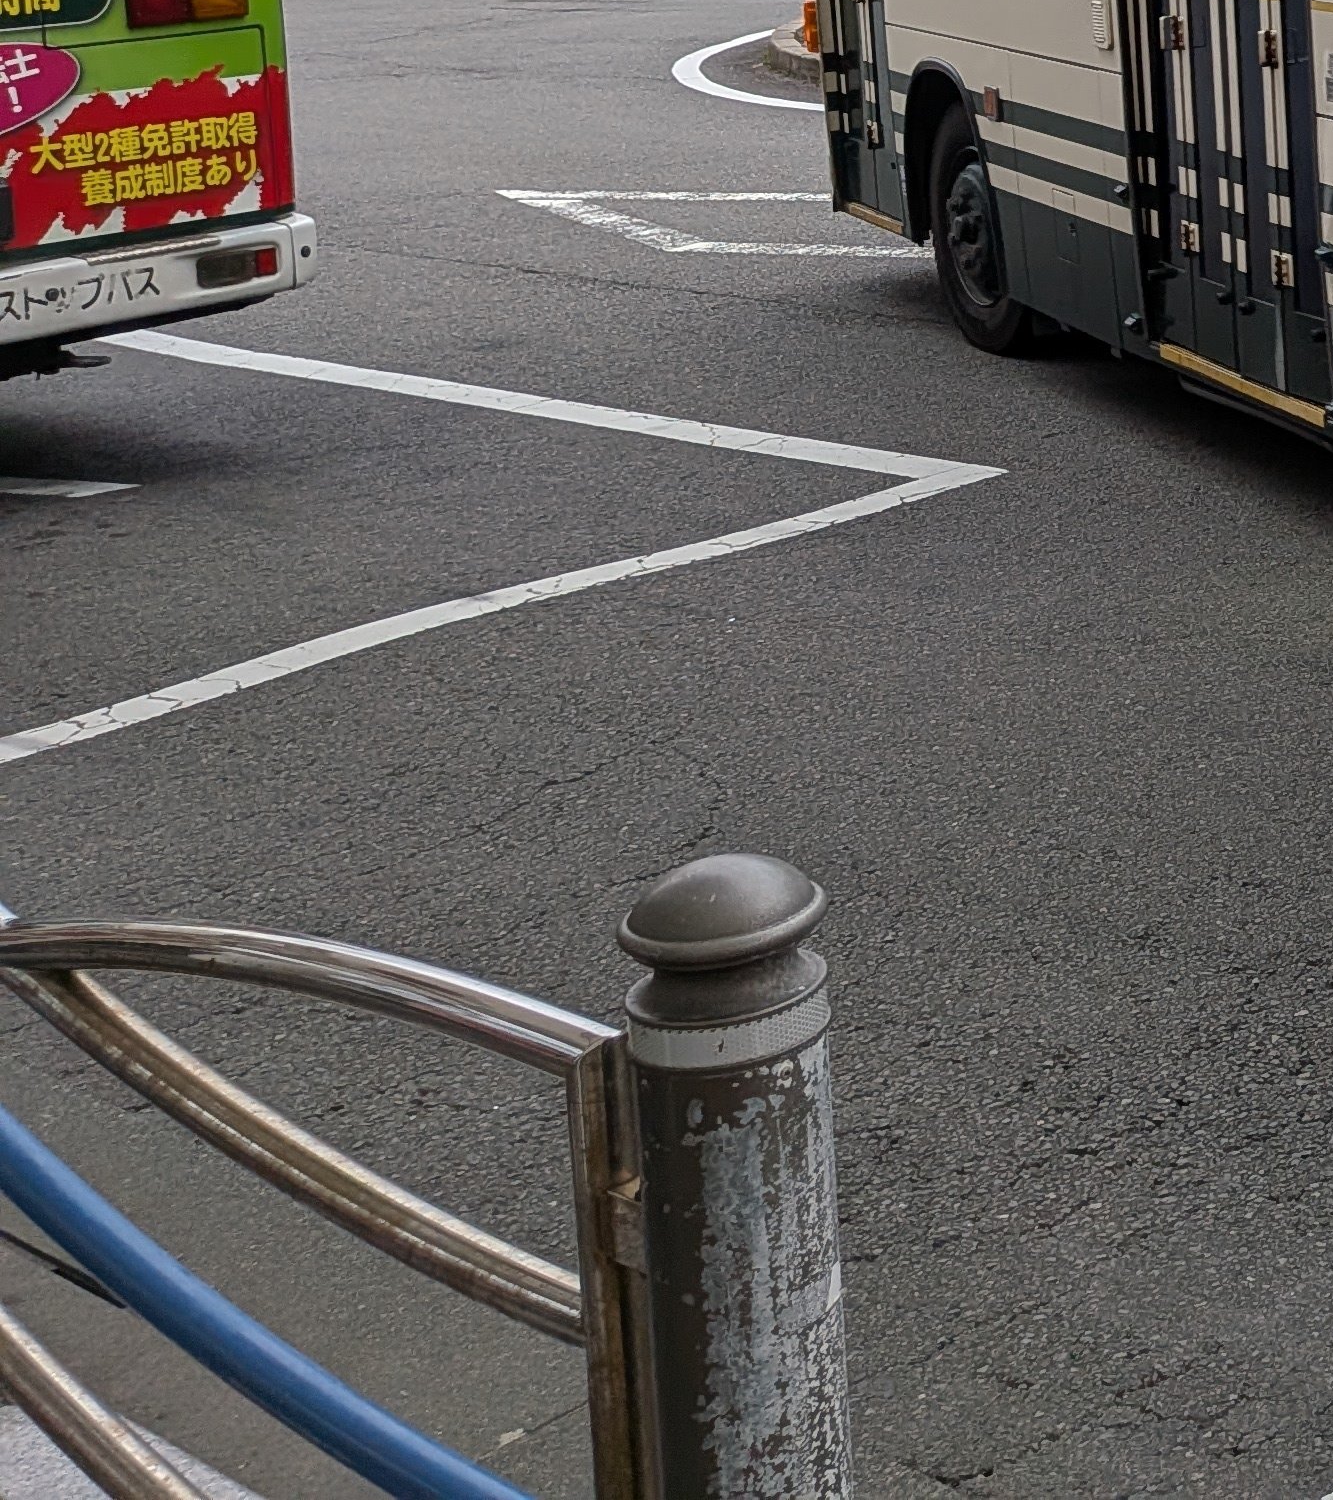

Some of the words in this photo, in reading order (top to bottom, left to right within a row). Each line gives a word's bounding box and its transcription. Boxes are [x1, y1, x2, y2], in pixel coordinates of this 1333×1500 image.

[30, 111, 258, 175] 大型2種免許取得
[81, 149, 258, 207] 養成制度あり
